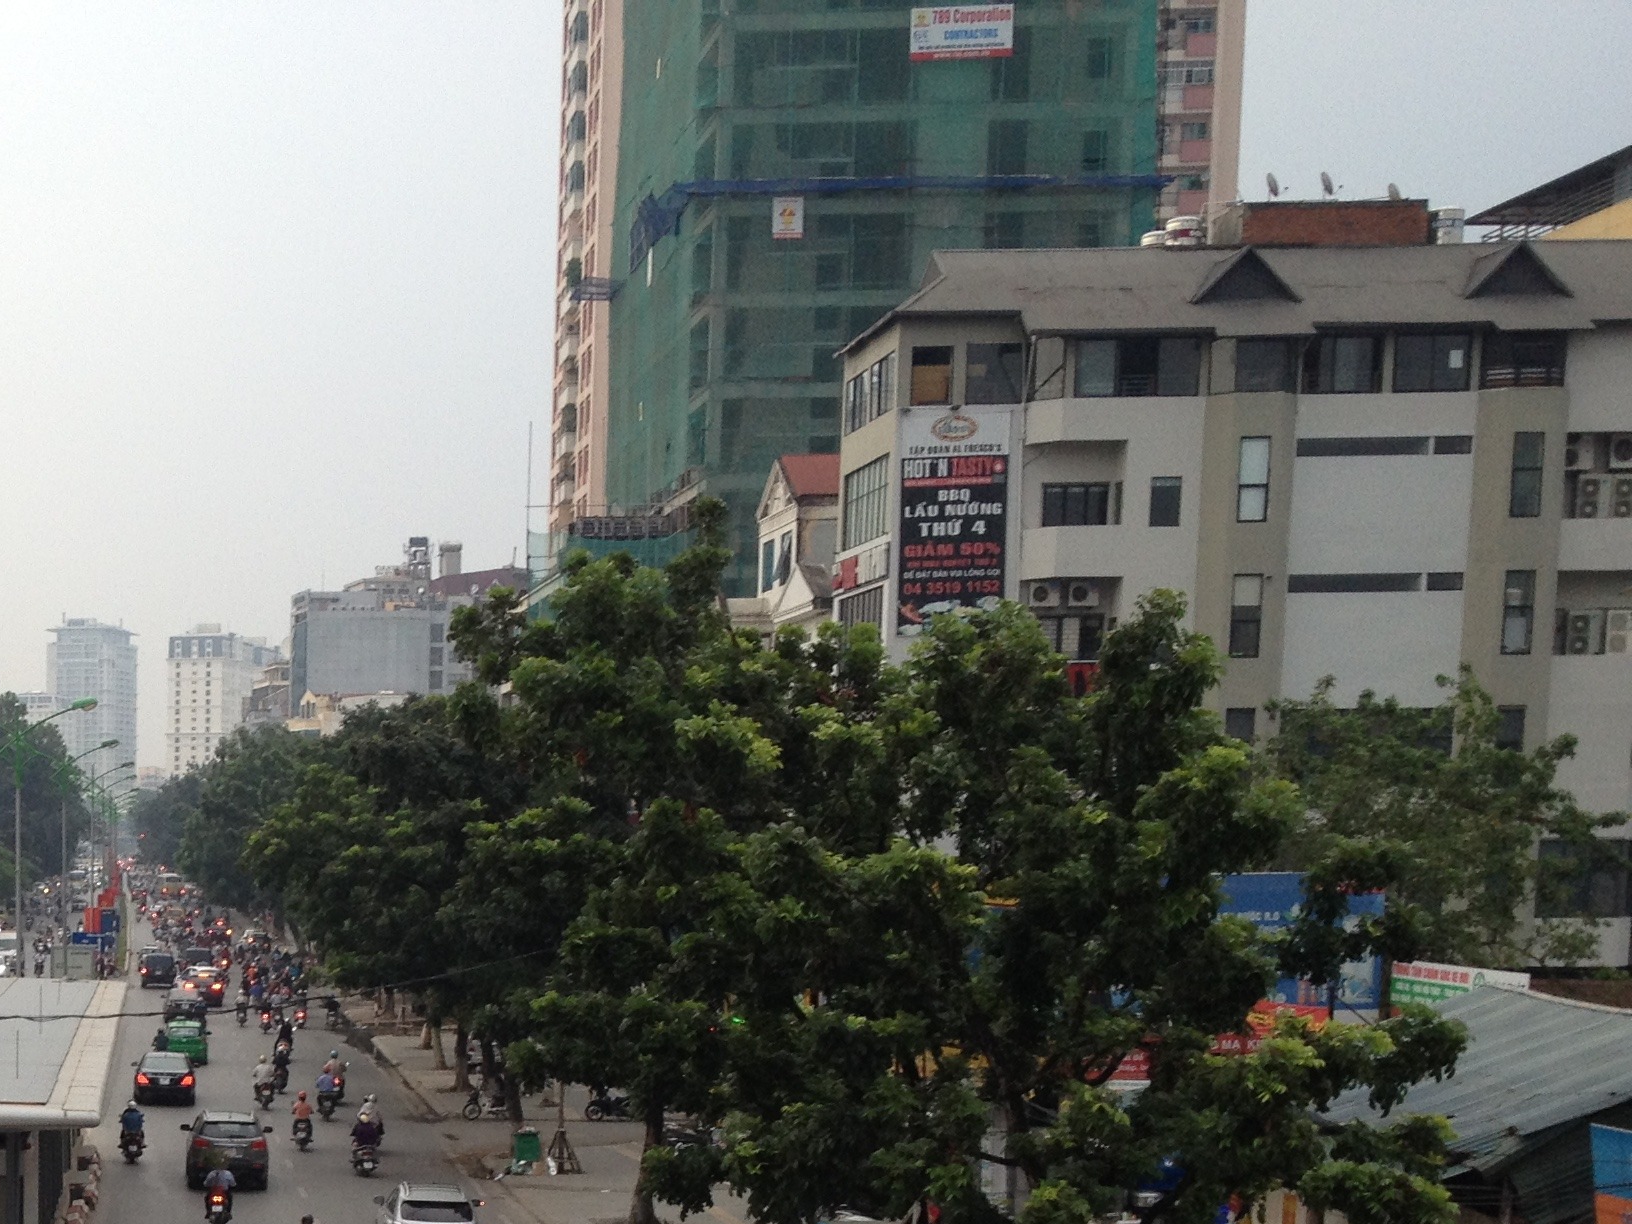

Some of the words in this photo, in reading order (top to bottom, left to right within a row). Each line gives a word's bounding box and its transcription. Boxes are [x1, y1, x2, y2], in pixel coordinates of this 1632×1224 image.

[951, 456, 993, 477] TASTY
[937, 488, 971, 502] BBQ
[944, 501, 1003, 516] NƯỚNG
[918, 518, 963, 537] THỨ
[971, 520, 987, 535] 4
[904, 541, 955, 558] GIẢM
[959, 542, 1001, 556] 50%
[903, 582, 922, 595] 04
[967, 580, 1000, 593] 1152
